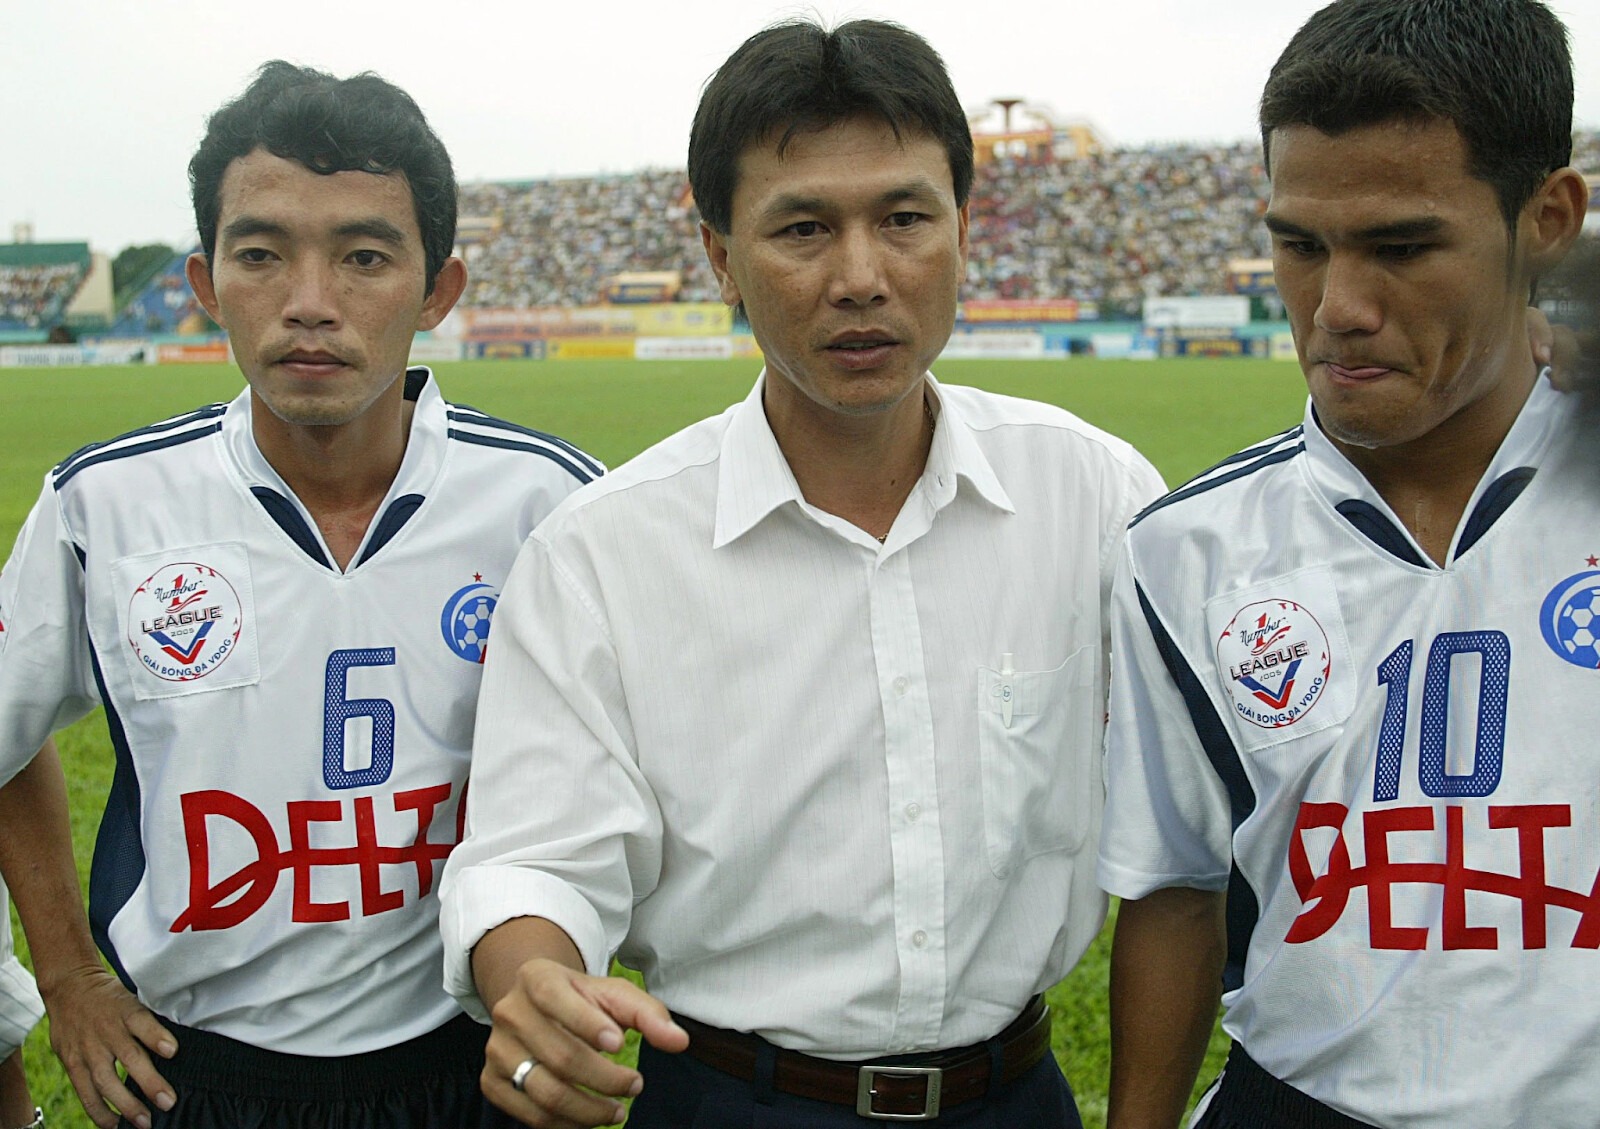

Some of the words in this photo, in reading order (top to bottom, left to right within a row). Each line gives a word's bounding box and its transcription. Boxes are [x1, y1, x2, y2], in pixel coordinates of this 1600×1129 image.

[155, 578, 202, 602] Number
[142, 606, 223, 634] LEAGUE
[171, 628, 194, 638] 2005
[1230, 641, 1310, 681] LEAGUE
[323, 647, 396, 790] 6
[1373, 630, 1511, 802] 10
[169, 777, 470, 933] DELT
